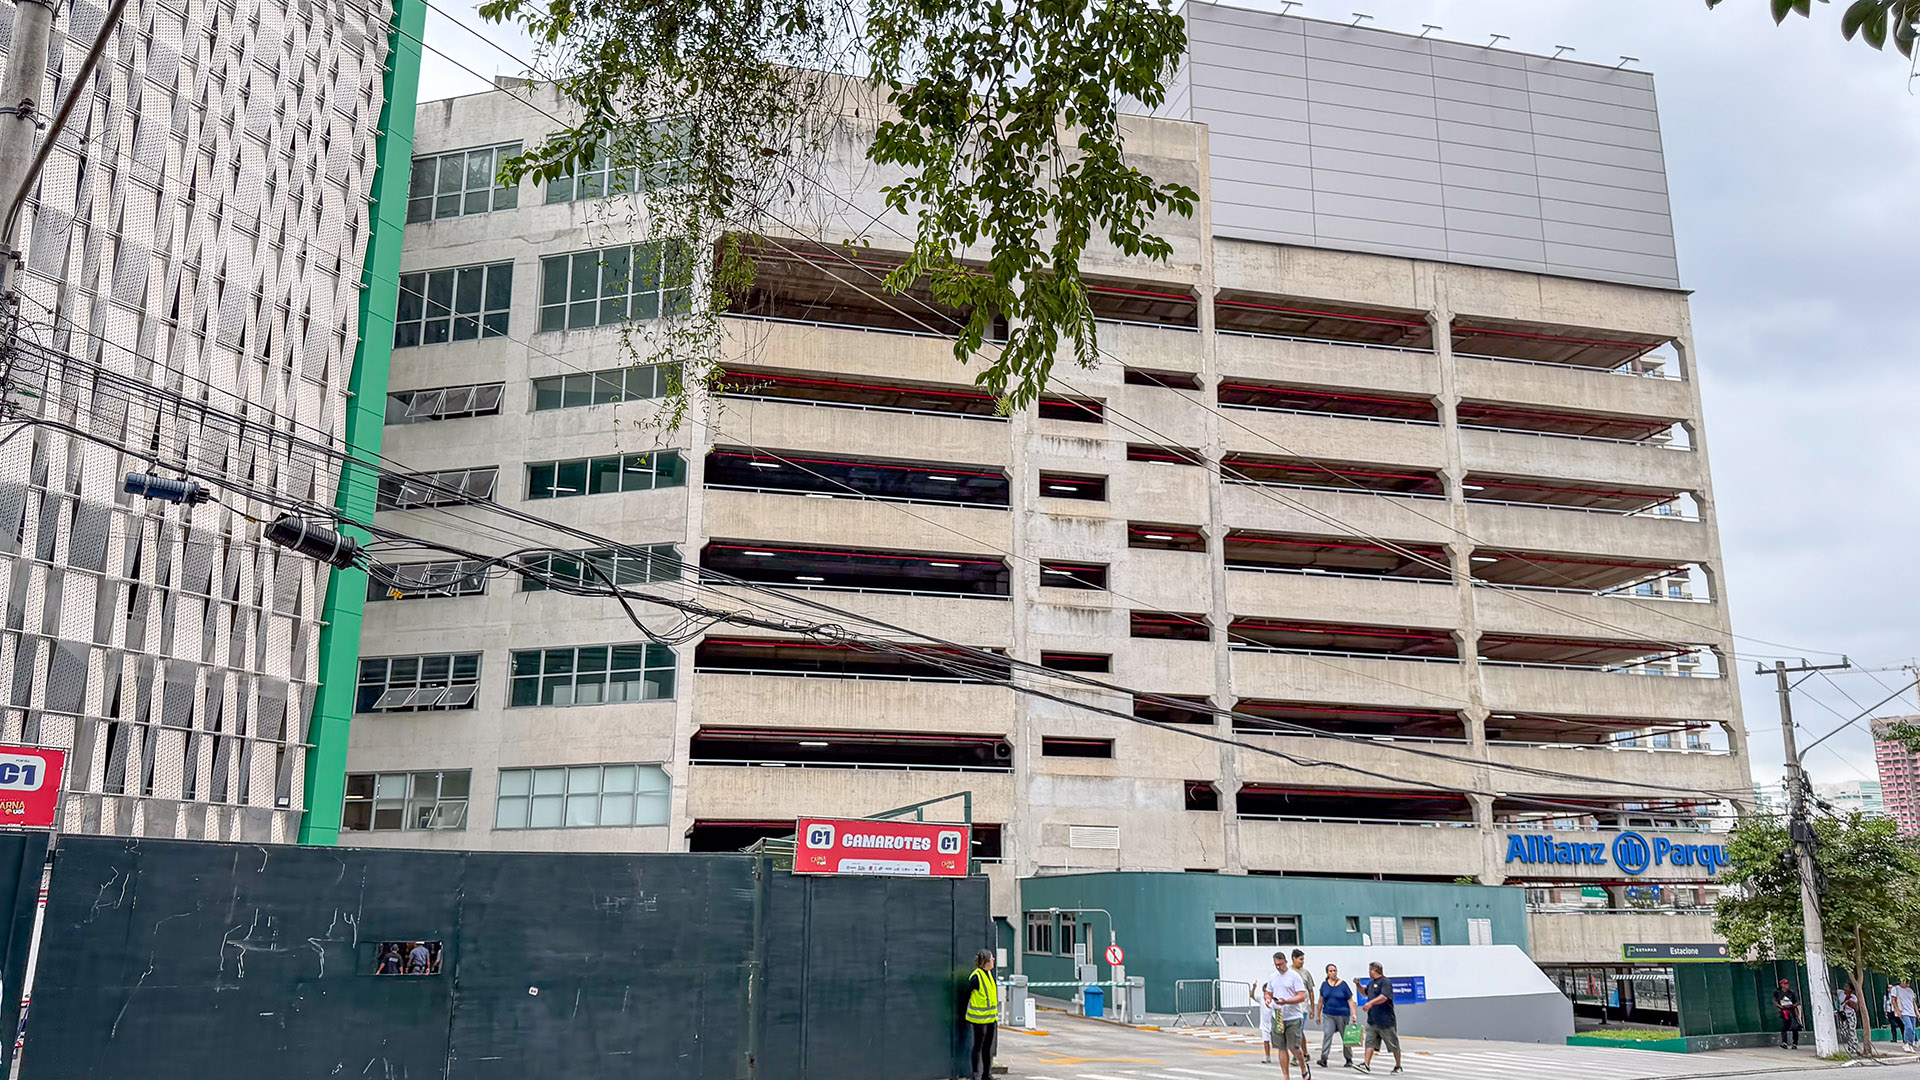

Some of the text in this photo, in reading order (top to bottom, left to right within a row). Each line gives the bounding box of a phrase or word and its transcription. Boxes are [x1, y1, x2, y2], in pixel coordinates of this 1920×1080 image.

[0, 763, 37, 785] C1
[0, 801, 26, 810] ARNA
[810, 830, 958, 851] C1 CAMAROTES C1
[1505, 834, 1730, 875] Allianz Parqu
[1669, 946, 1699, 955] Estacione
